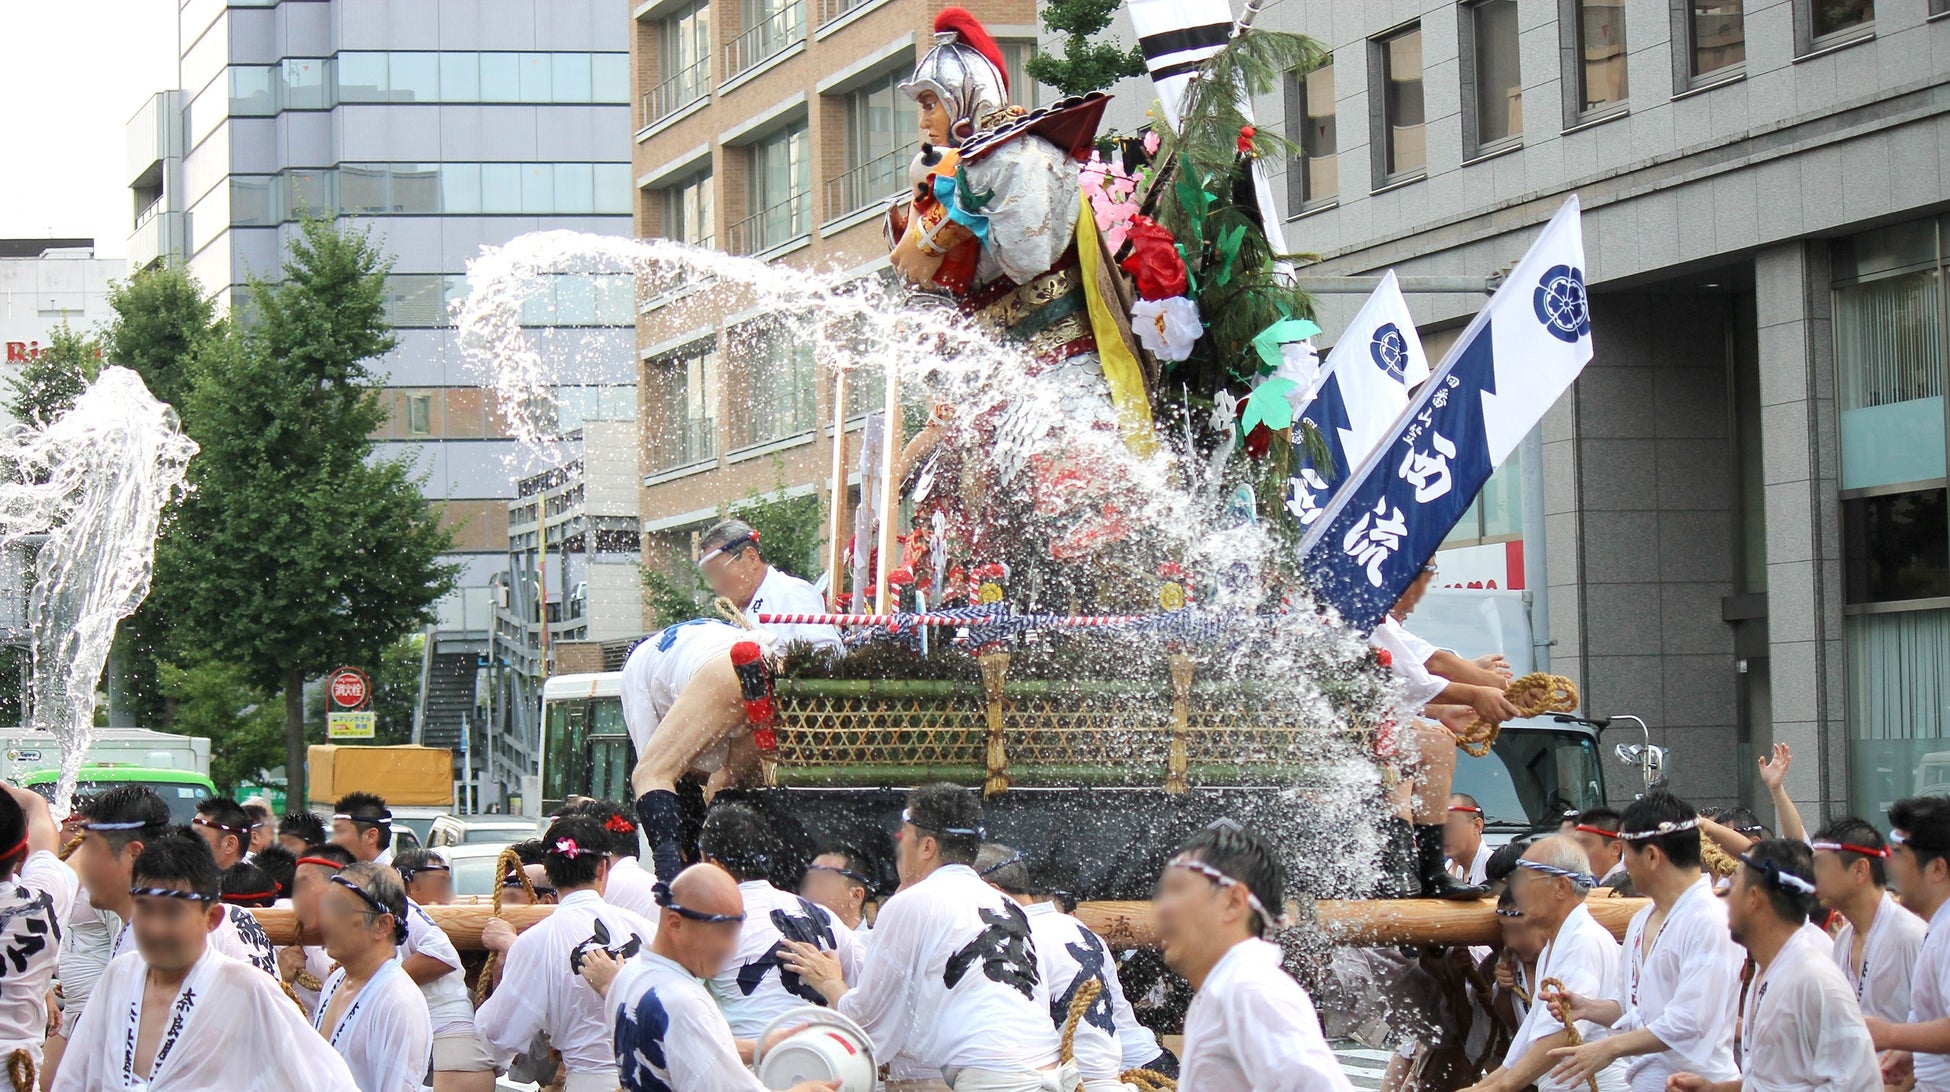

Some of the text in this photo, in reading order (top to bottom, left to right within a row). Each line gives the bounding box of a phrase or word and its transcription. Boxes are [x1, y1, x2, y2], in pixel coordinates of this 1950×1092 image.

[1402, 373, 1460, 447] 四番山笠
[1343, 430, 1457, 588] 西流
[334, 683, 362, 697] 消火栓
